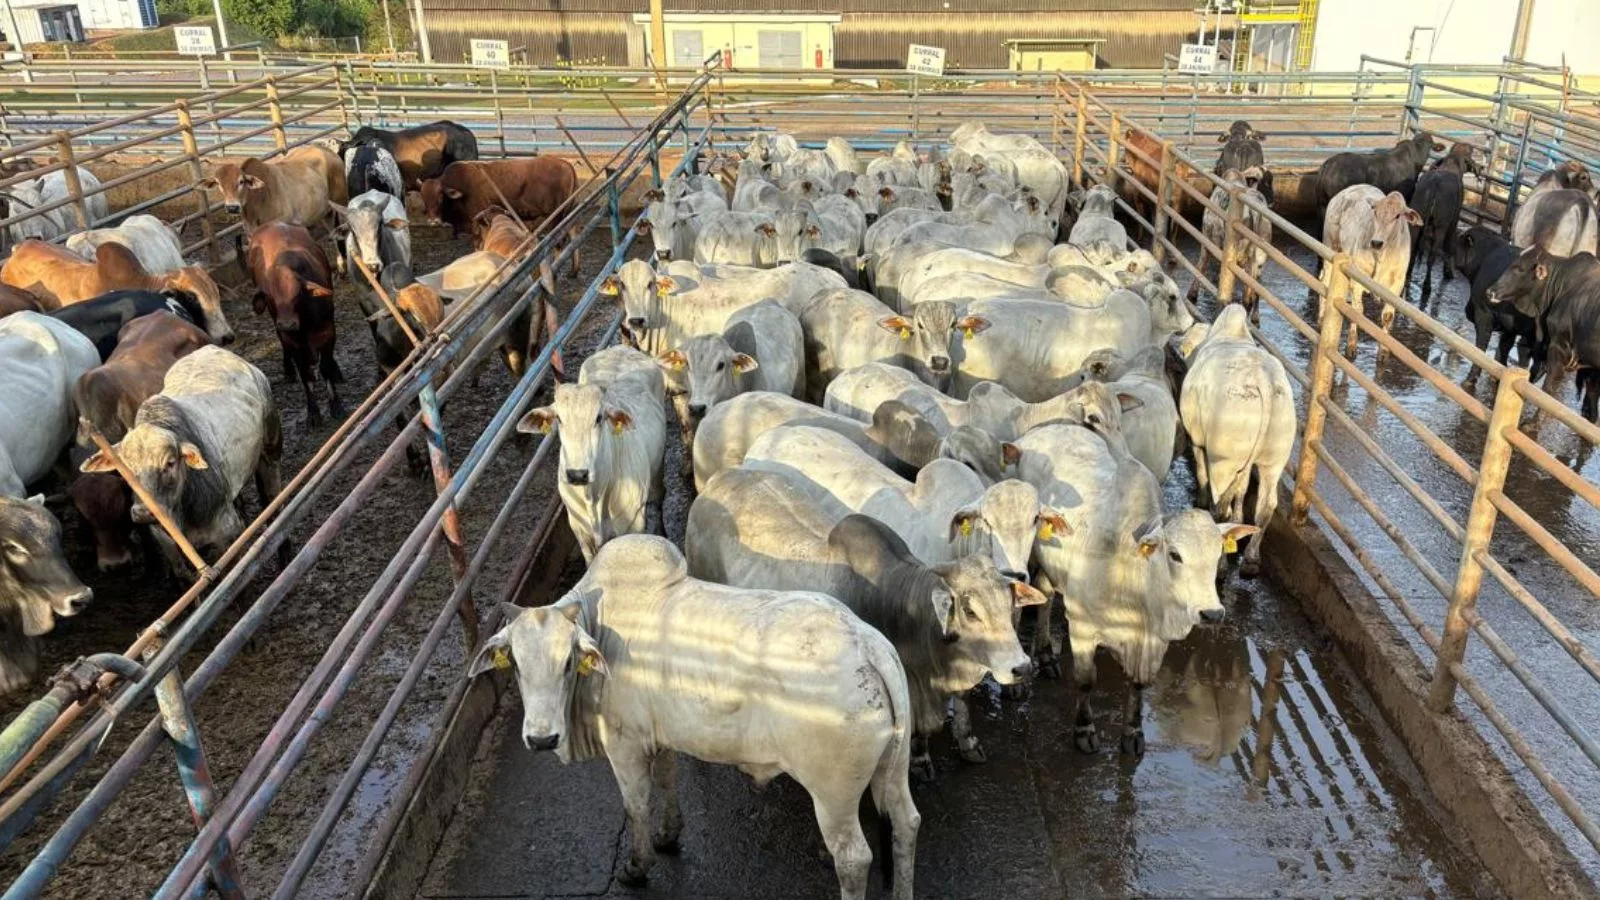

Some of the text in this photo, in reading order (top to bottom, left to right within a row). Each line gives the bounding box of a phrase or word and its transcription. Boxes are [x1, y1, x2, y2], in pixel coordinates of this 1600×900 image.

[180, 28, 208, 37] CURRAL
[476, 41, 504, 50] CURRAL
[486, 50, 496, 59] 40
[914, 47, 940, 58] CURRAL
[1185, 46, 1211, 55] CURRAL
[922, 58, 931, 66] 42
